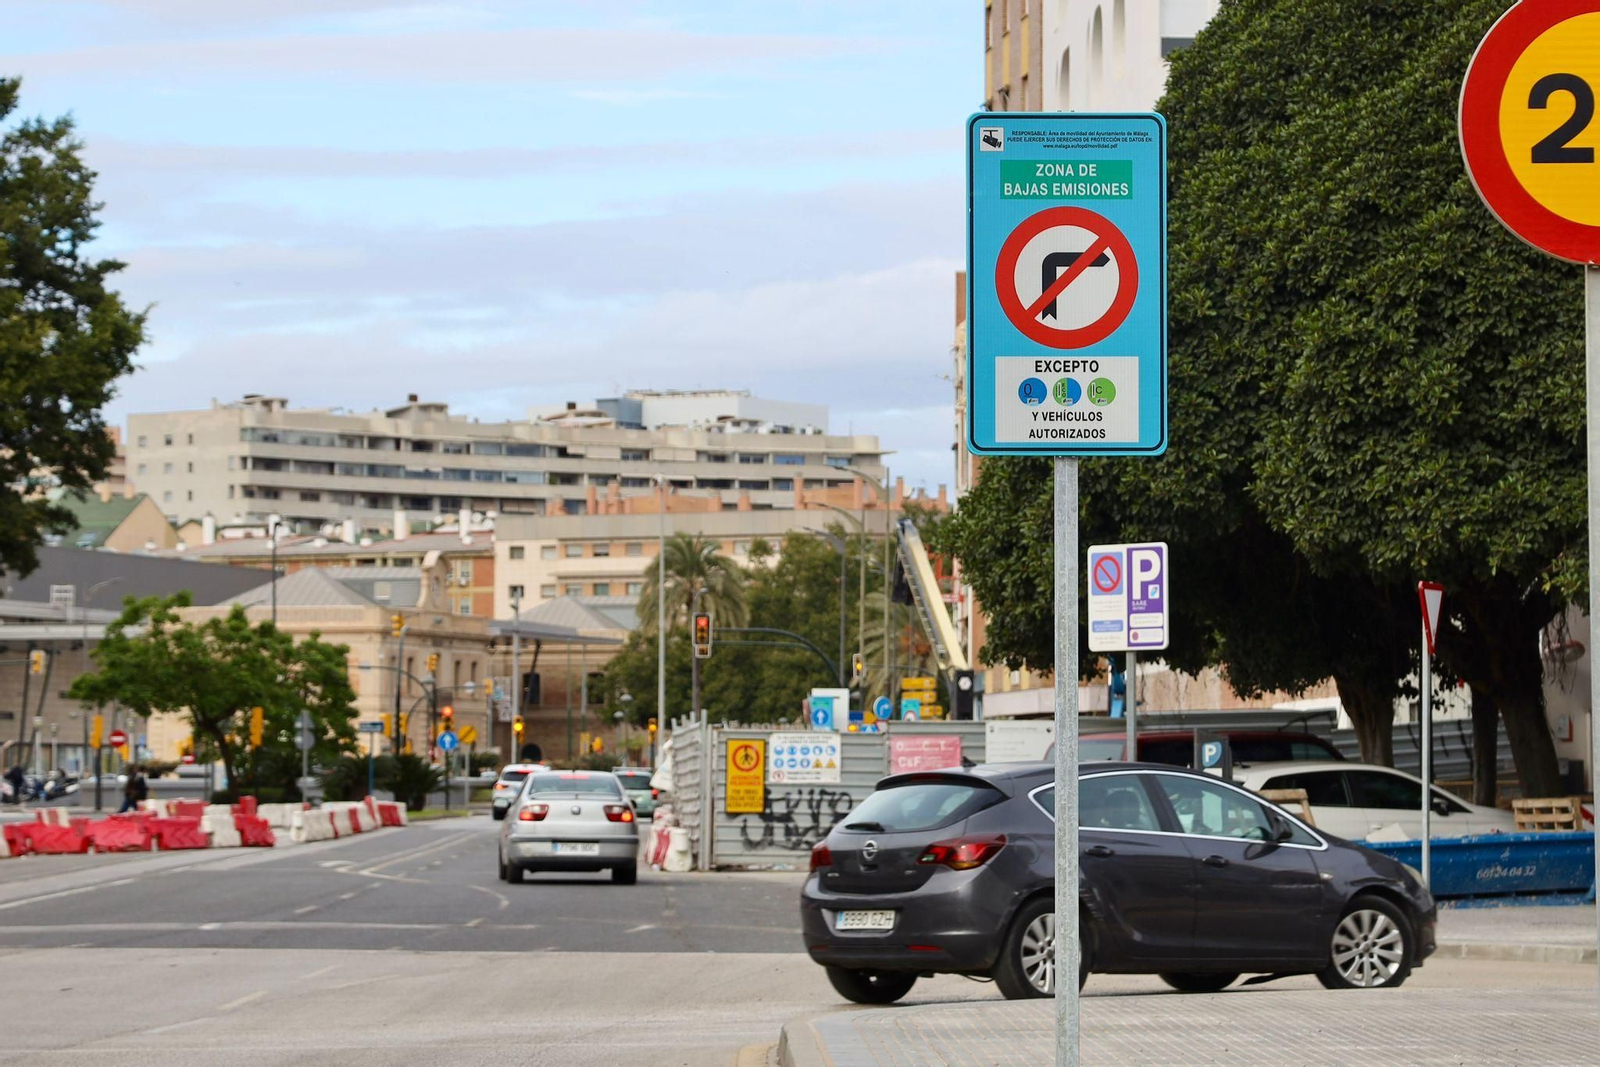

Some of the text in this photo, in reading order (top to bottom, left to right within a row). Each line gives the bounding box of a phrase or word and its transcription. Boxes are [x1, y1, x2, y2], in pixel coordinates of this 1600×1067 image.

[1528, 73, 1595, 163] 2
[1035, 164, 1097, 177] ZONA DE
[1003, 183, 1129, 196] BAJAS EMISIONES
[1035, 360, 1099, 373] EXCEPTO
[1032, 409, 1103, 421] Y VEHÍCULOS
[1029, 429, 1106, 439] AUTORIZADOS
[1132, 549, 1162, 600] P
[1205, 744, 1217, 762] P
